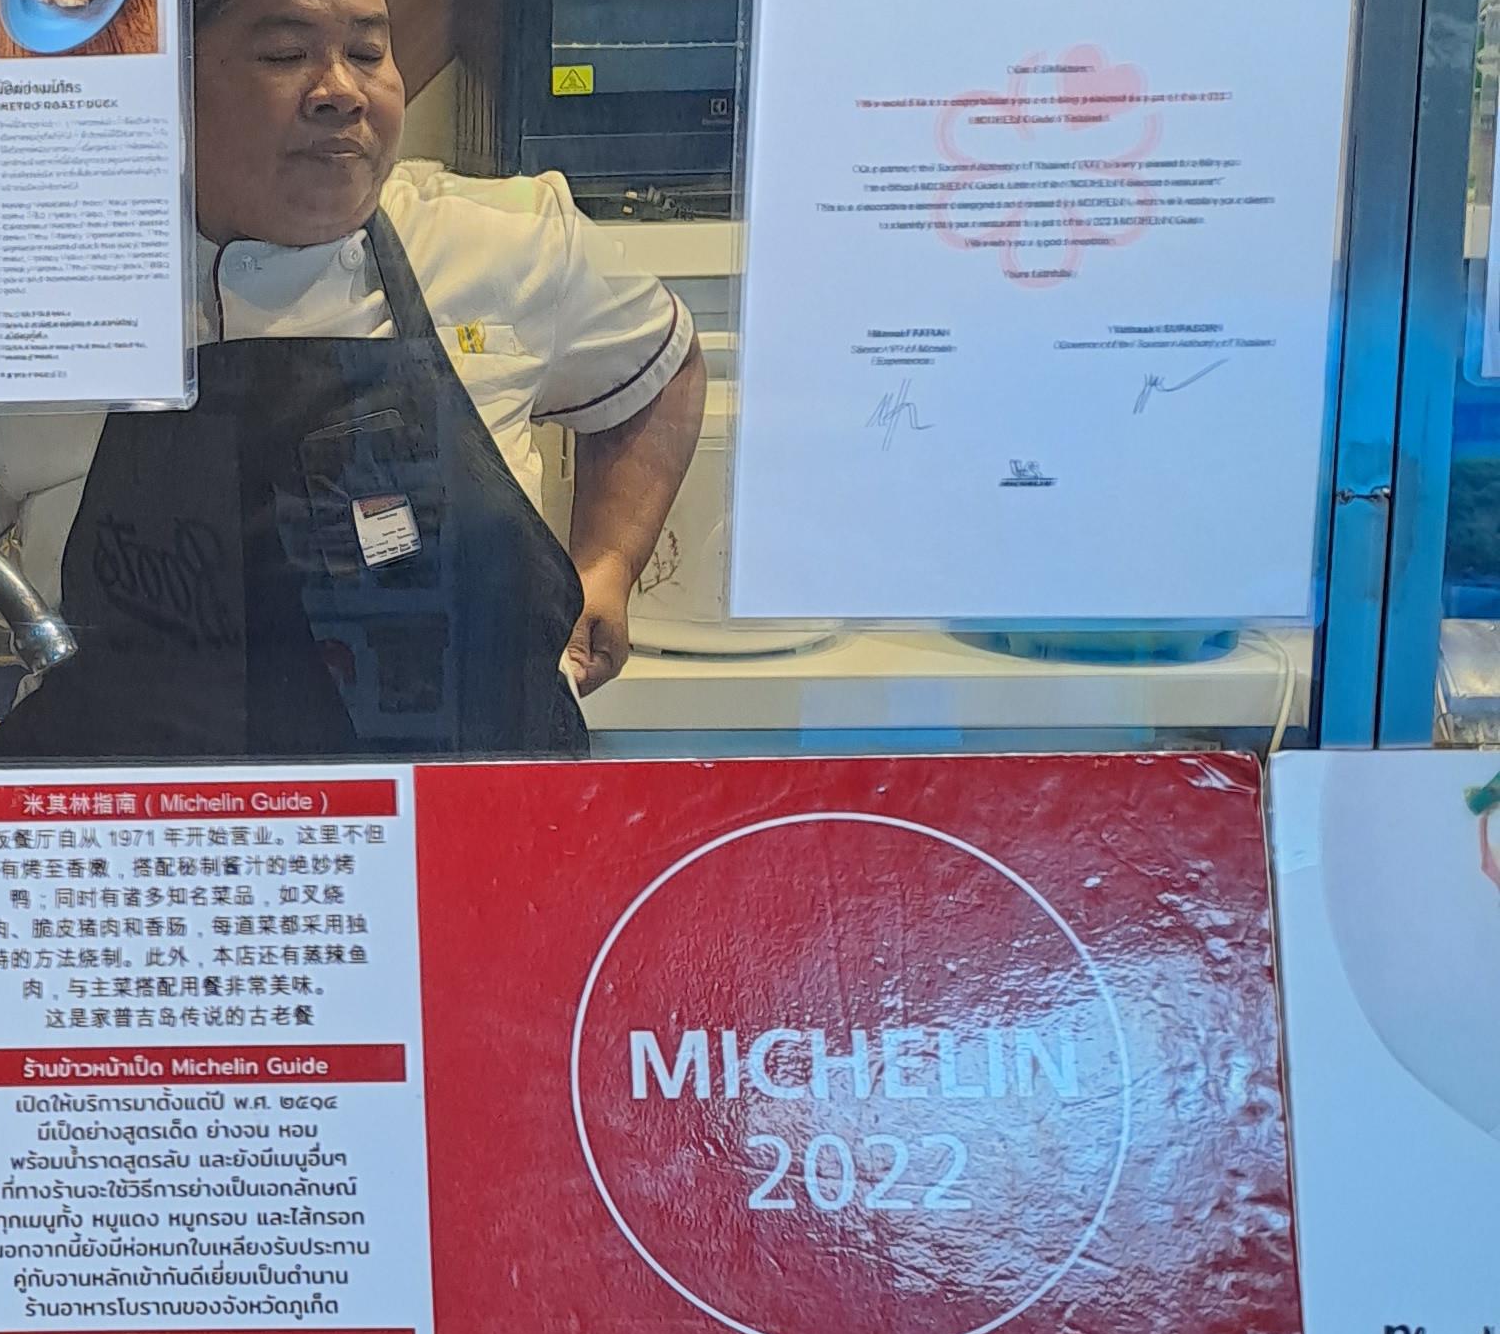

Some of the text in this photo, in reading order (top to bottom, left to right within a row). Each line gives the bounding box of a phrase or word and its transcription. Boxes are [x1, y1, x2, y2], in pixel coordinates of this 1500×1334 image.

[24, 793, 136, 816] 米其林指南
[161, 792, 244, 812] Michelin
[251, 791, 313, 811] Guide
[109, 829, 155, 847] 1971
[23, 1055, 329, 1078] ร้านข้าวหน้าเป็ด Michelin Guide
[631, 1030, 1079, 1099] MICHELIN
[15, 1087, 225, 1113] เปิดให้บริการมาตั้งแต่ปี
[234, 1096, 271, 1110] พ.ศ.
[37, 1118, 318, 1146] มีเป็ดย่างสูตรเด็ด ย่างจน หอม
[10, 1142, 347, 1175] พร้อมน้ำราดสูตรลับ และยังมีเมนูอื่นๆ
[748, 1134, 972, 1210] 2022
[1, 1175, 357, 1200] ที่ทางร้านจะใช้วิธีการย่างเป็นเอกลักษณ์
[92, 1212, 159, 1233] หมูแดง
[168, 1211, 247, 1232] หมูกรอบ
[257, 1205, 365, 1226] และไส้กรอก
[14, 1260, 348, 1293] คู่กับจานหลักเข้ากันดีเยี่ยมเป็นตำนาน
[25, 1292, 339, 1320] ร้านอาหารโบราณของจังหวัดภูเก็ต
